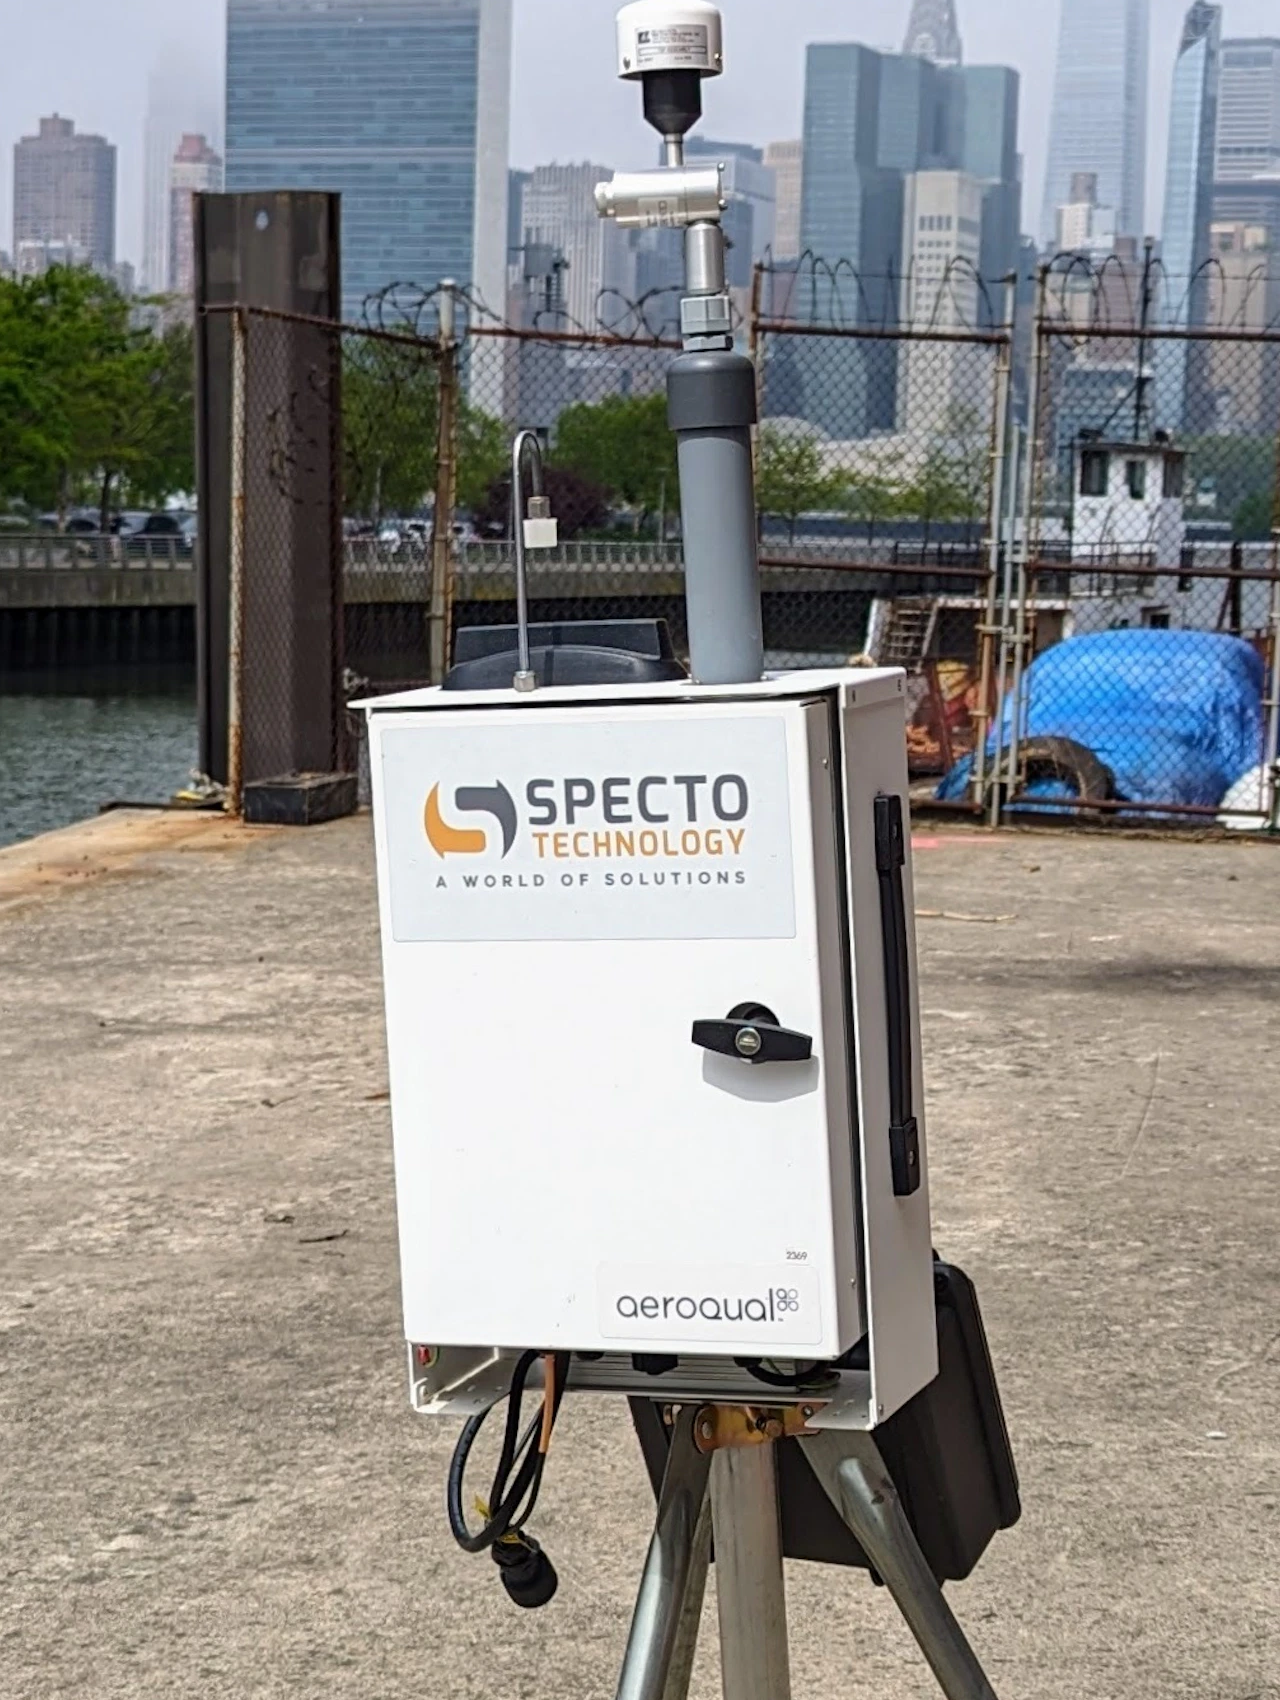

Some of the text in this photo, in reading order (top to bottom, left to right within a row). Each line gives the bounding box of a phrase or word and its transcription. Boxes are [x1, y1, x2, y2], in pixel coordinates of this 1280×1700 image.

[526, 774, 748, 825] SPECTO
[532, 828, 746, 858] TECHNOLOGY
[436, 871, 746, 888] A WORLD OF SOLUTIONS
[616, 1288, 775, 1322] aeroqual
